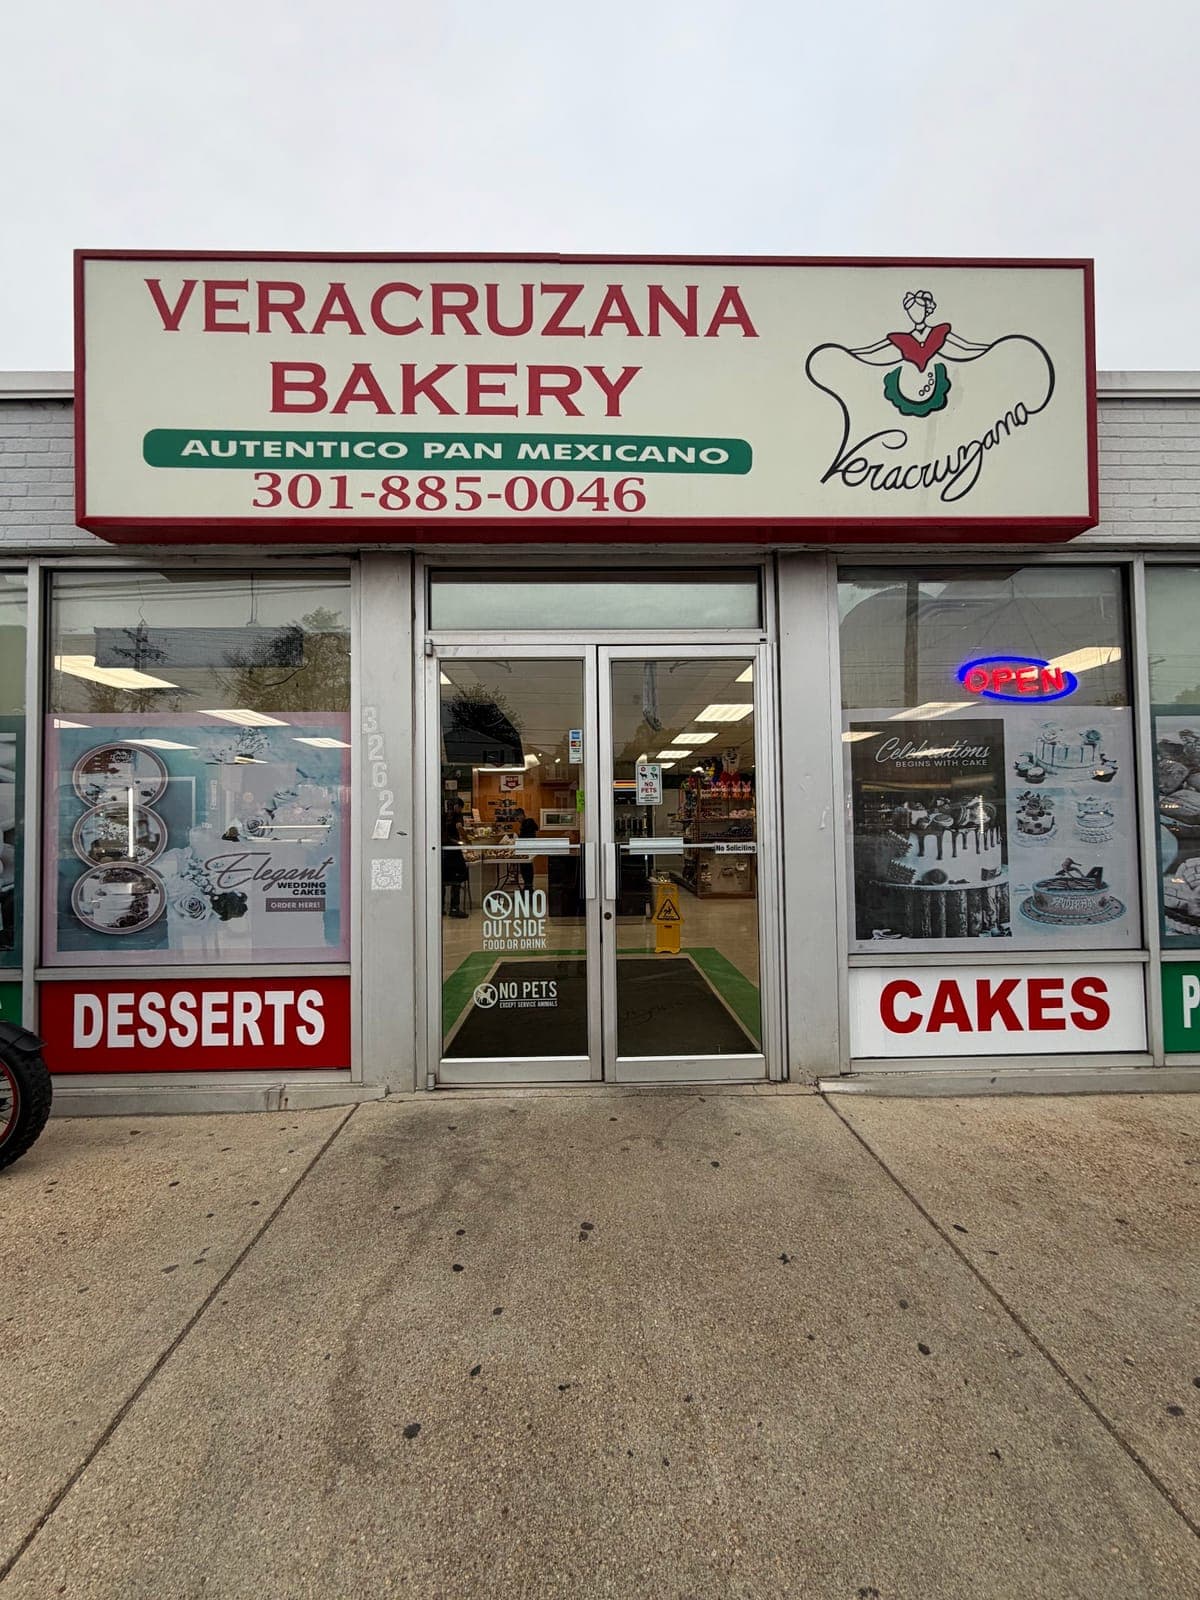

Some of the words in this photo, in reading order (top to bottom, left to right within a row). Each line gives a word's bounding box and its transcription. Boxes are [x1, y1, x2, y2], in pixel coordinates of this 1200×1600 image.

[144, 278, 759, 338] VERACRUZANA
[270, 361, 641, 418] BAKERY
[181, 439, 408, 460] AUTENTICO
[423, 442, 503, 461] PAN
[517, 443, 730, 465] MEXICANO
[820, 401, 1033, 502] Veracruzana
[252, 472, 647, 513] 301-885-0046
[964, 667, 1065, 694] OPEN
[362, 706, 395, 816] 3262
[715, 844, 724, 852] No
[726, 844, 756, 852] Soliciting
[204, 852, 334, 891] Elegant
[513, 889, 547, 919] NO
[483, 919, 547, 938] OUTSIDE
[483, 939, 506, 950] FOOD
[507, 939, 519, 949] OR
[520, 938, 547, 949] DRINK
[499, 981, 518, 999] NO
[522, 980, 558, 998] PETS
[879, 977, 1109, 1034] CAKES
[72, 990, 325, 1049] DESSERTS
